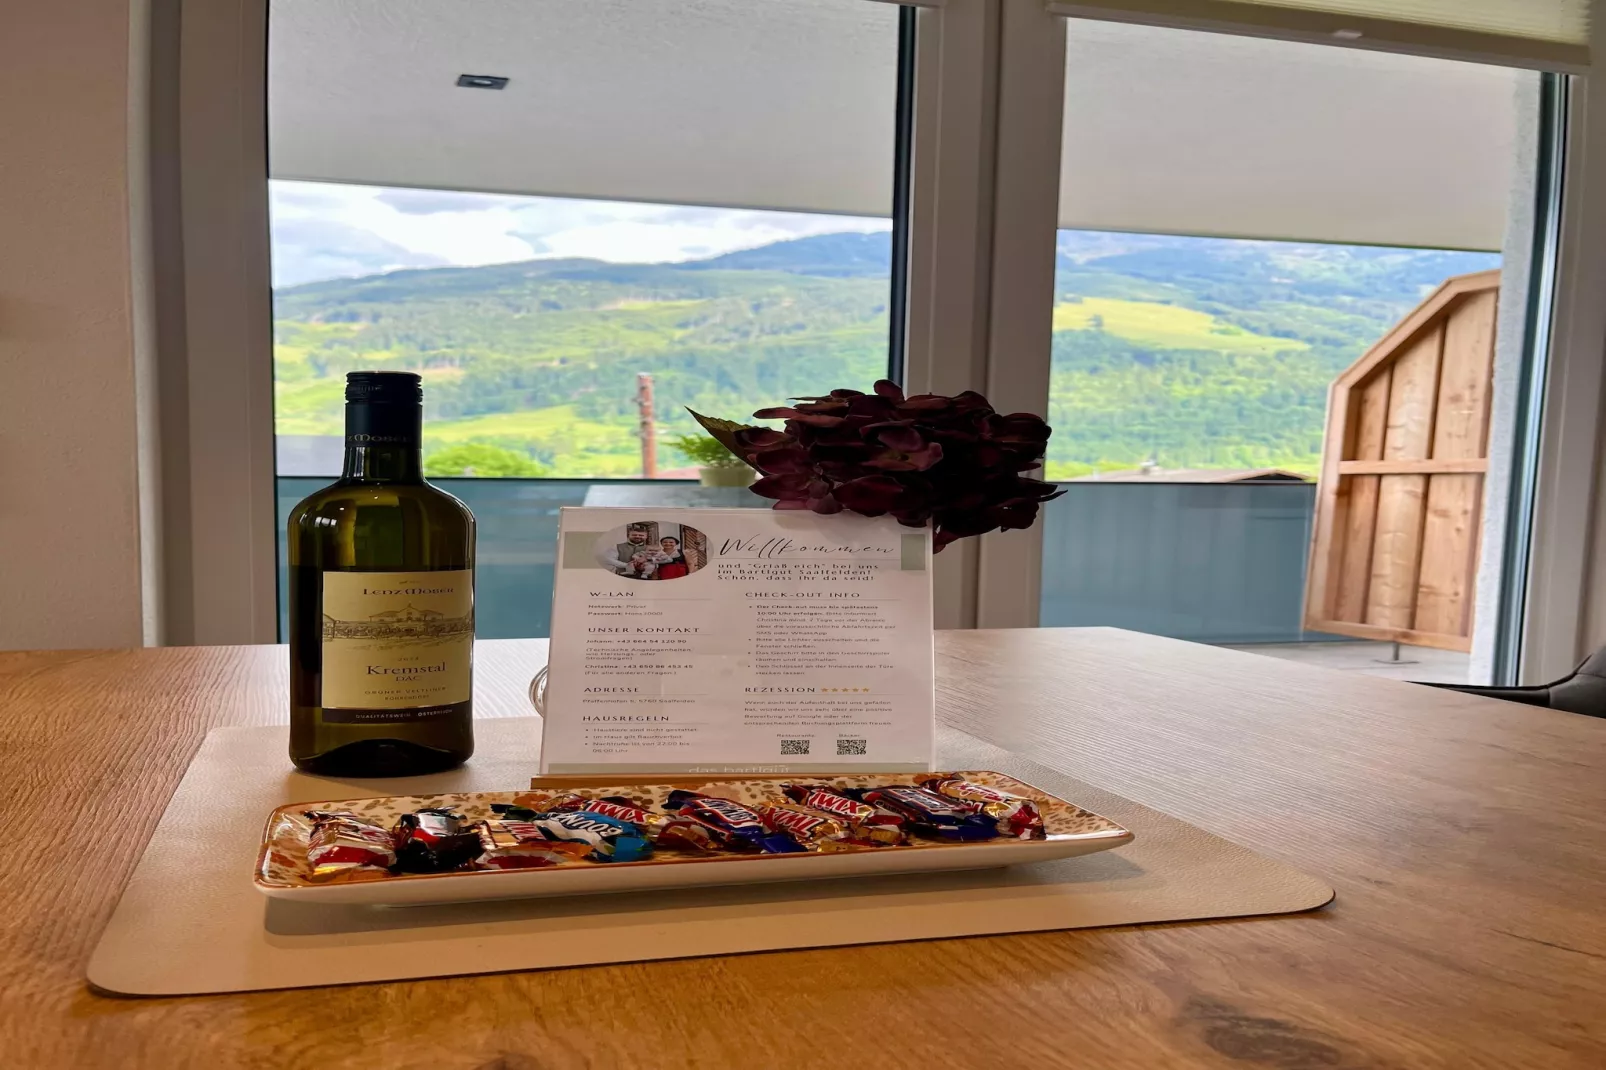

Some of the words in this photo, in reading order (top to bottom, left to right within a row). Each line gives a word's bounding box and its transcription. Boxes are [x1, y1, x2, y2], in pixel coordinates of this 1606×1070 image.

[719, 533, 894, 558] Willkommen
[366, 661, 446, 675] Kremstal
[586, 799, 649, 824] TWIX
[808, 790, 862, 816] TWIX
